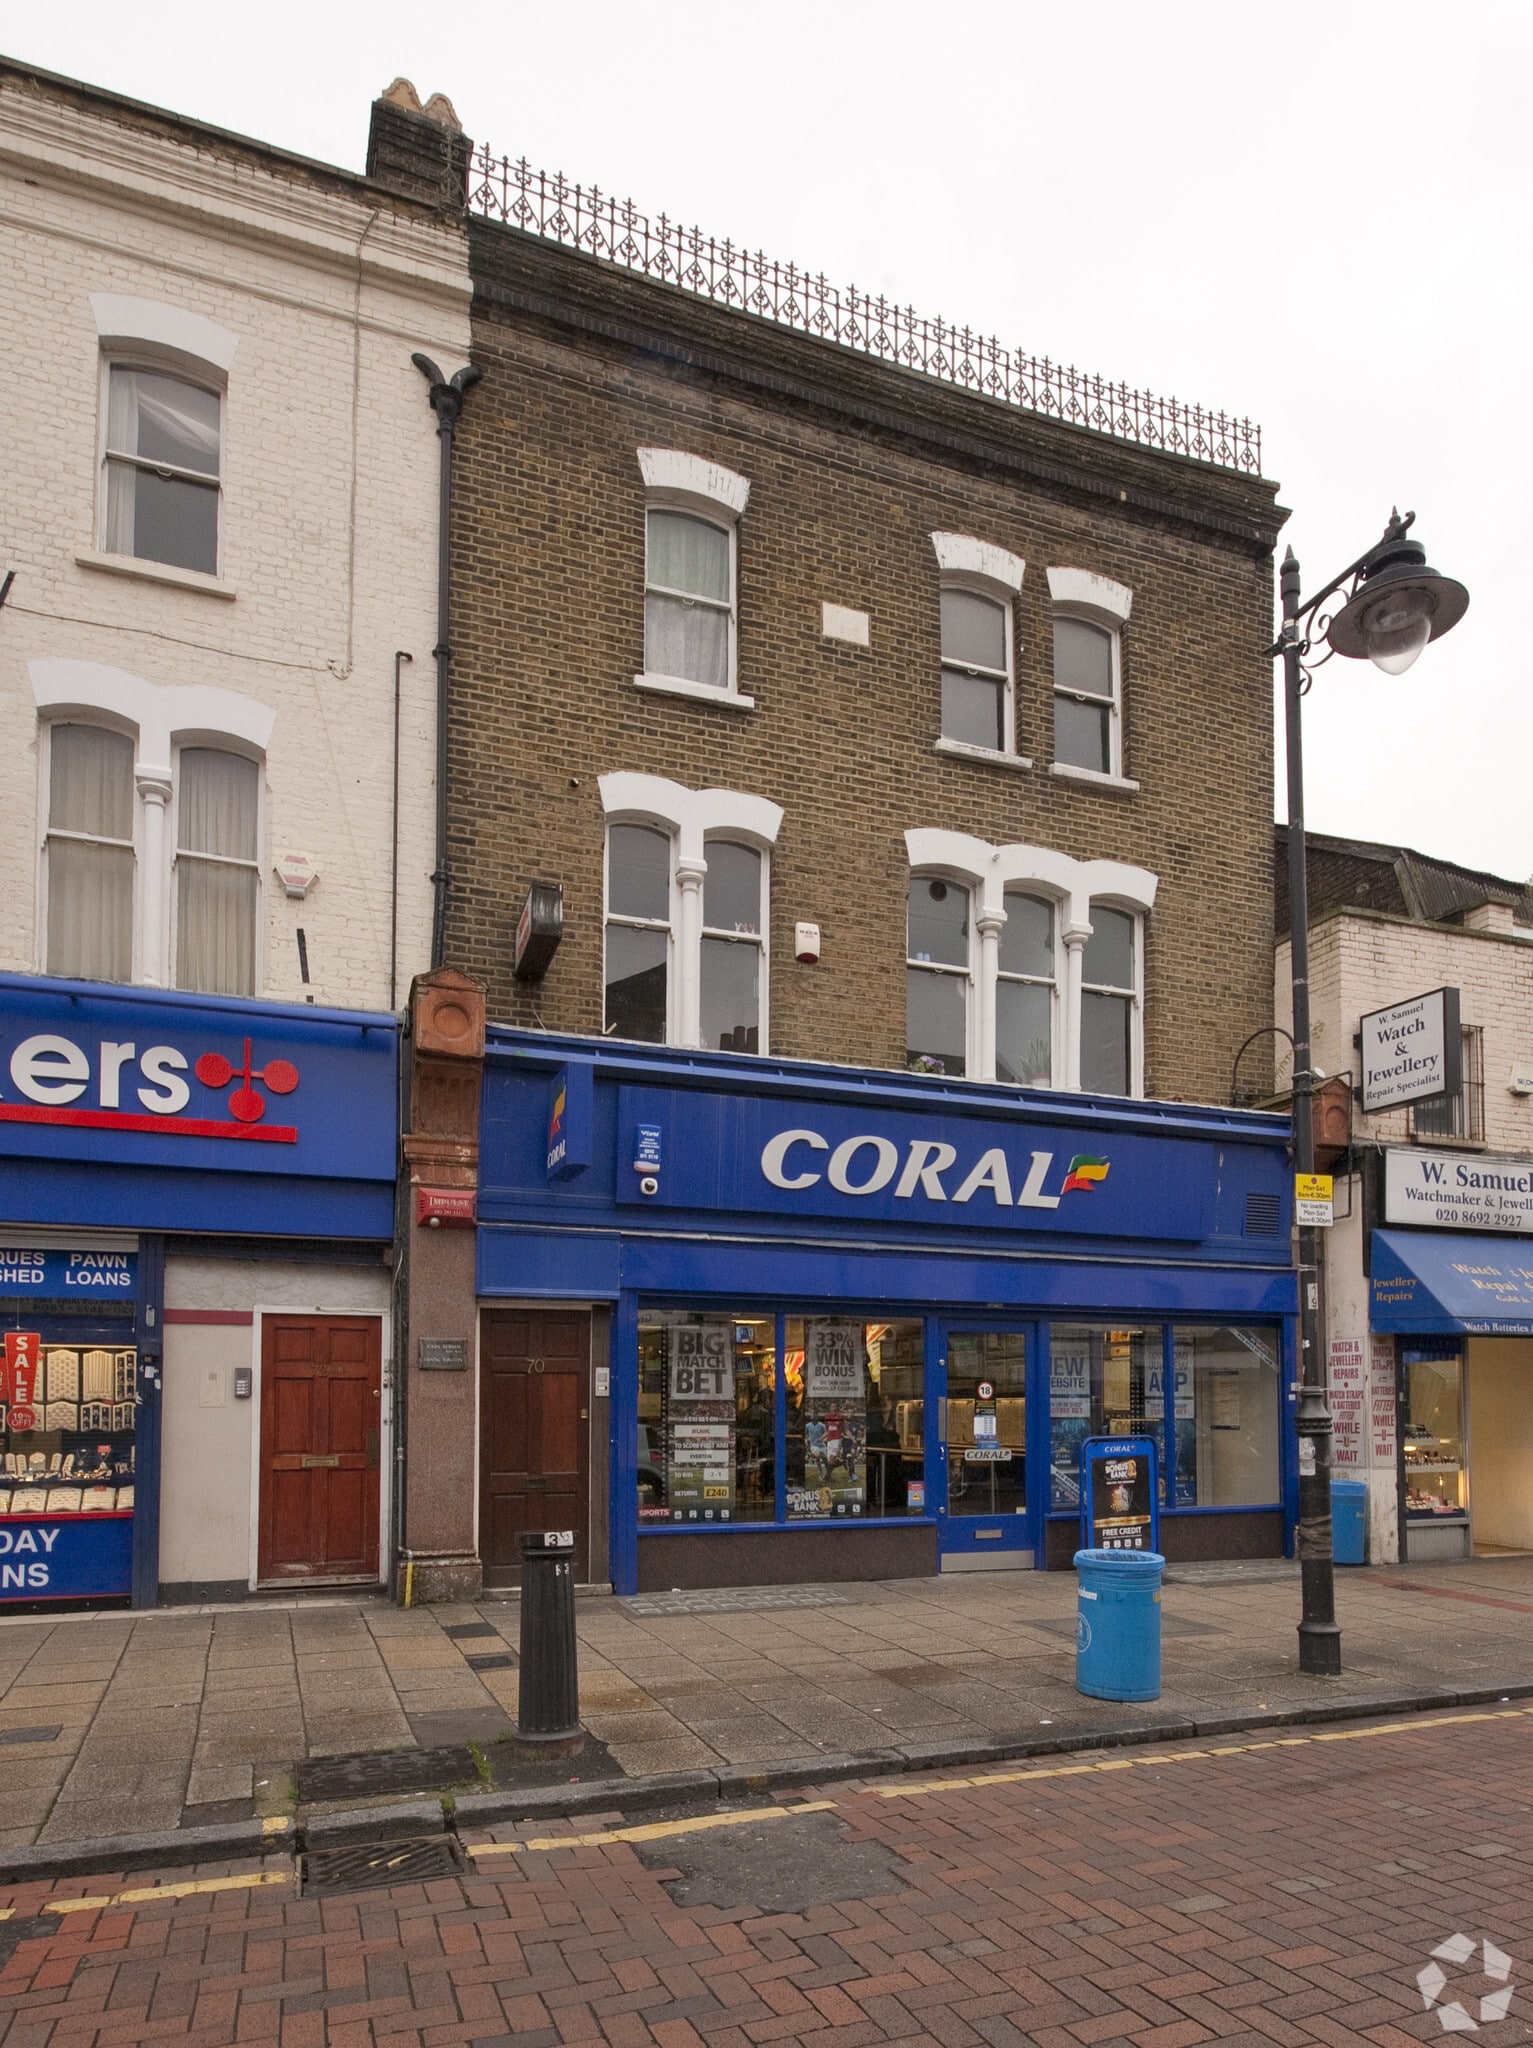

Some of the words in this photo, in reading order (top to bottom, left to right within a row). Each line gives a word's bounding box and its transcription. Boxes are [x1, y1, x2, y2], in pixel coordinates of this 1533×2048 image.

[1391, 1002, 1424, 1021] Samuel
[1377, 1018, 1425, 1044] Watch
[1395, 1041, 1409, 1056] &
[0, 1034, 190, 1114] ers
[1367, 1054, 1439, 1087] Jewellery
[1366, 1085, 1394, 1100] Repair
[1396, 1074, 1440, 1093] Specialist
[547, 1139, 566, 1169] CORAL
[760, 1129, 1061, 1209] CORAL
[1421, 1161, 1447, 1185] W.
[1456, 1164, 1533, 1193] Samuel
[1405, 1187, 1481, 1206] Watchmaker
[1484, 1195, 1495, 1207] &
[1435, 1208, 1458, 1222] 020
[1462, 1211, 1490, 1225] 8692
[1494, 1214, 1522, 1227] 2927
[70, 1253, 128, 1268] PAWN
[1451, 1263, 1502, 1276] Watch
[0, 1269, 45, 1284] HED
[65, 1271, 131, 1286] LOANS
[1373, 1276, 1418, 1289] Jewellery
[1471, 1278, 1519, 1293] Repai
[1376, 1291, 1413, 1303] Repairs
[1463, 1322, 1490, 1332] Watch
[1492, 1322, 1529, 1333] Batteries
[678, 1332, 725, 1355] BIG
[815, 1332, 854, 1348] 33%
[1331, 1341, 1352, 1353] WATCH
[1354, 1340, 1360, 1352] &
[815, 1349, 854, 1365] WIN
[1373, 1346, 1392, 1357] WATCH
[526, 1358, 545, 1374] 70
[677, 1355, 726, 1368] MATCH
[1328, 1354, 1362, 1366] JEWELLERY
[14, 1336, 30, 1403] SALE
[815, 1366, 856, 1377] BONUS
[1333, 1368, 1359, 1380] REPAIRS
[676, 1368, 727, 1394] BET
[1051, 1377, 1085, 1389] EBSITE
[1148, 1372, 1189, 1392] AP
[980, 1386, 991, 1395] 18
[1329, 1390, 1345, 1399] WATCH
[1346, 1390, 1364, 1399] STRAPS
[1371, 1386, 1395, 1396] BATTERIES
[1336, 1400, 1361, 1410] BATTERIES
[1373, 1399, 1395, 1411] FITTED
[1339, 1411, 1355, 1420] FITTED
[1372, 1414, 1395, 1427] WHILE
[11, 1419, 32, 1427] OFF!
[1333, 1422, 1360, 1434] WHILE
[966, 1451, 1005, 1459] CORAL
[1336, 1450, 1358, 1462] WAIT
[1375, 1444, 1393, 1456] WAIT
[706, 1488, 727, 1497] £240
[786, 1490, 820, 1504] BONUS
[638, 1508, 670, 1517] SPORTS
[794, 1501, 819, 1511] BANK
[1102, 1528, 1118, 1536] FREE
[1119, 1526, 1142, 1535] CREDIT
[2, 1563, 49, 1588] NS
